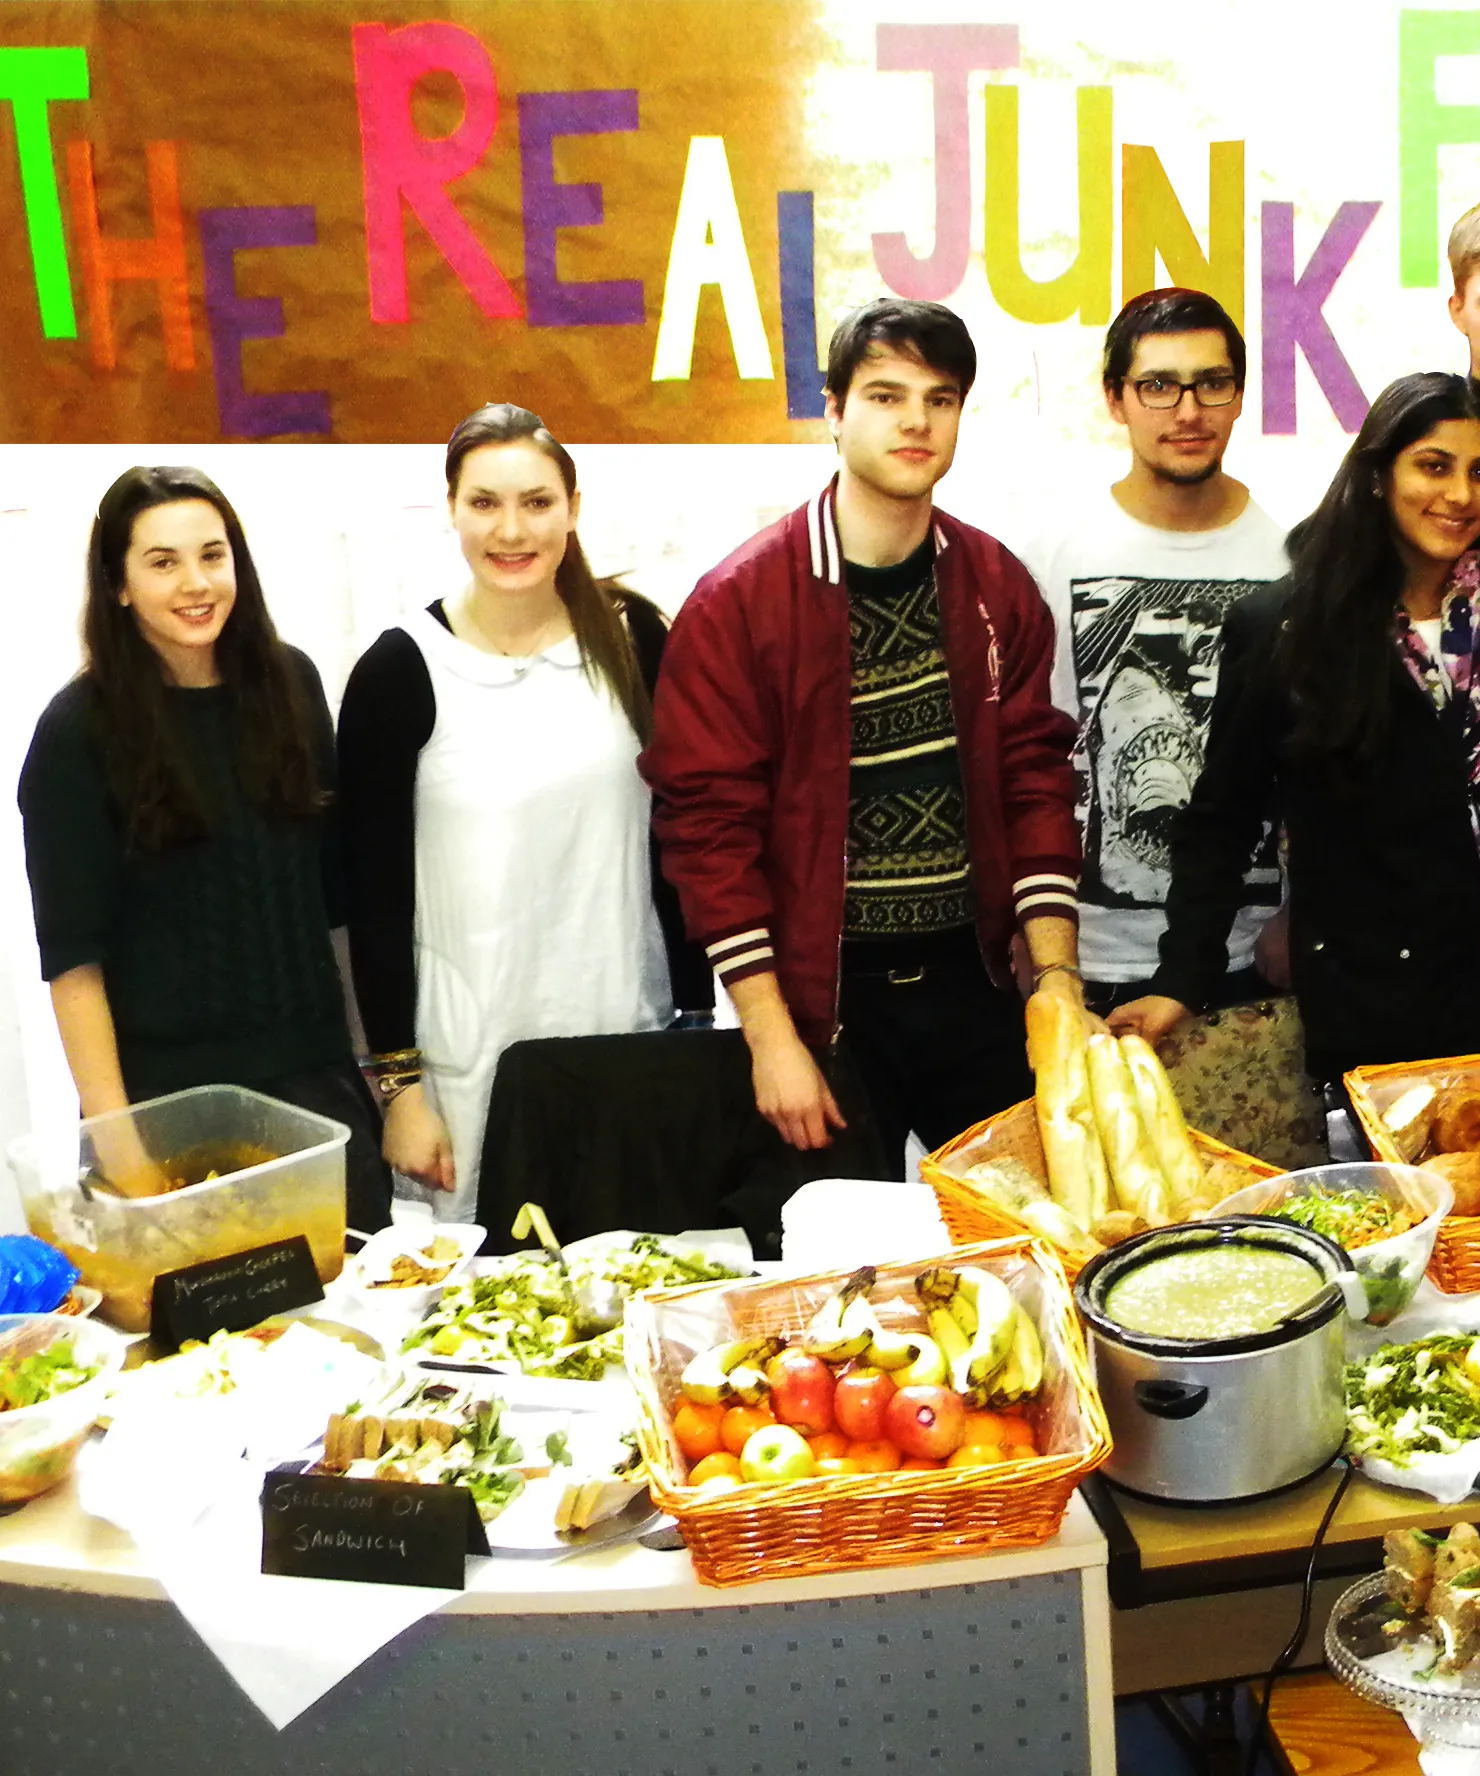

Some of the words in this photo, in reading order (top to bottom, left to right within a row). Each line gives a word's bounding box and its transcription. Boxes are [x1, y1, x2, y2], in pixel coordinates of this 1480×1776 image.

[0, 46, 332, 436] THE
[351, 19, 829, 420] REAL
[870, 22, 1384, 437] JUNK
[392, 1494, 426, 1516] OF
[291, 1523, 408, 1558] SANDWICH
